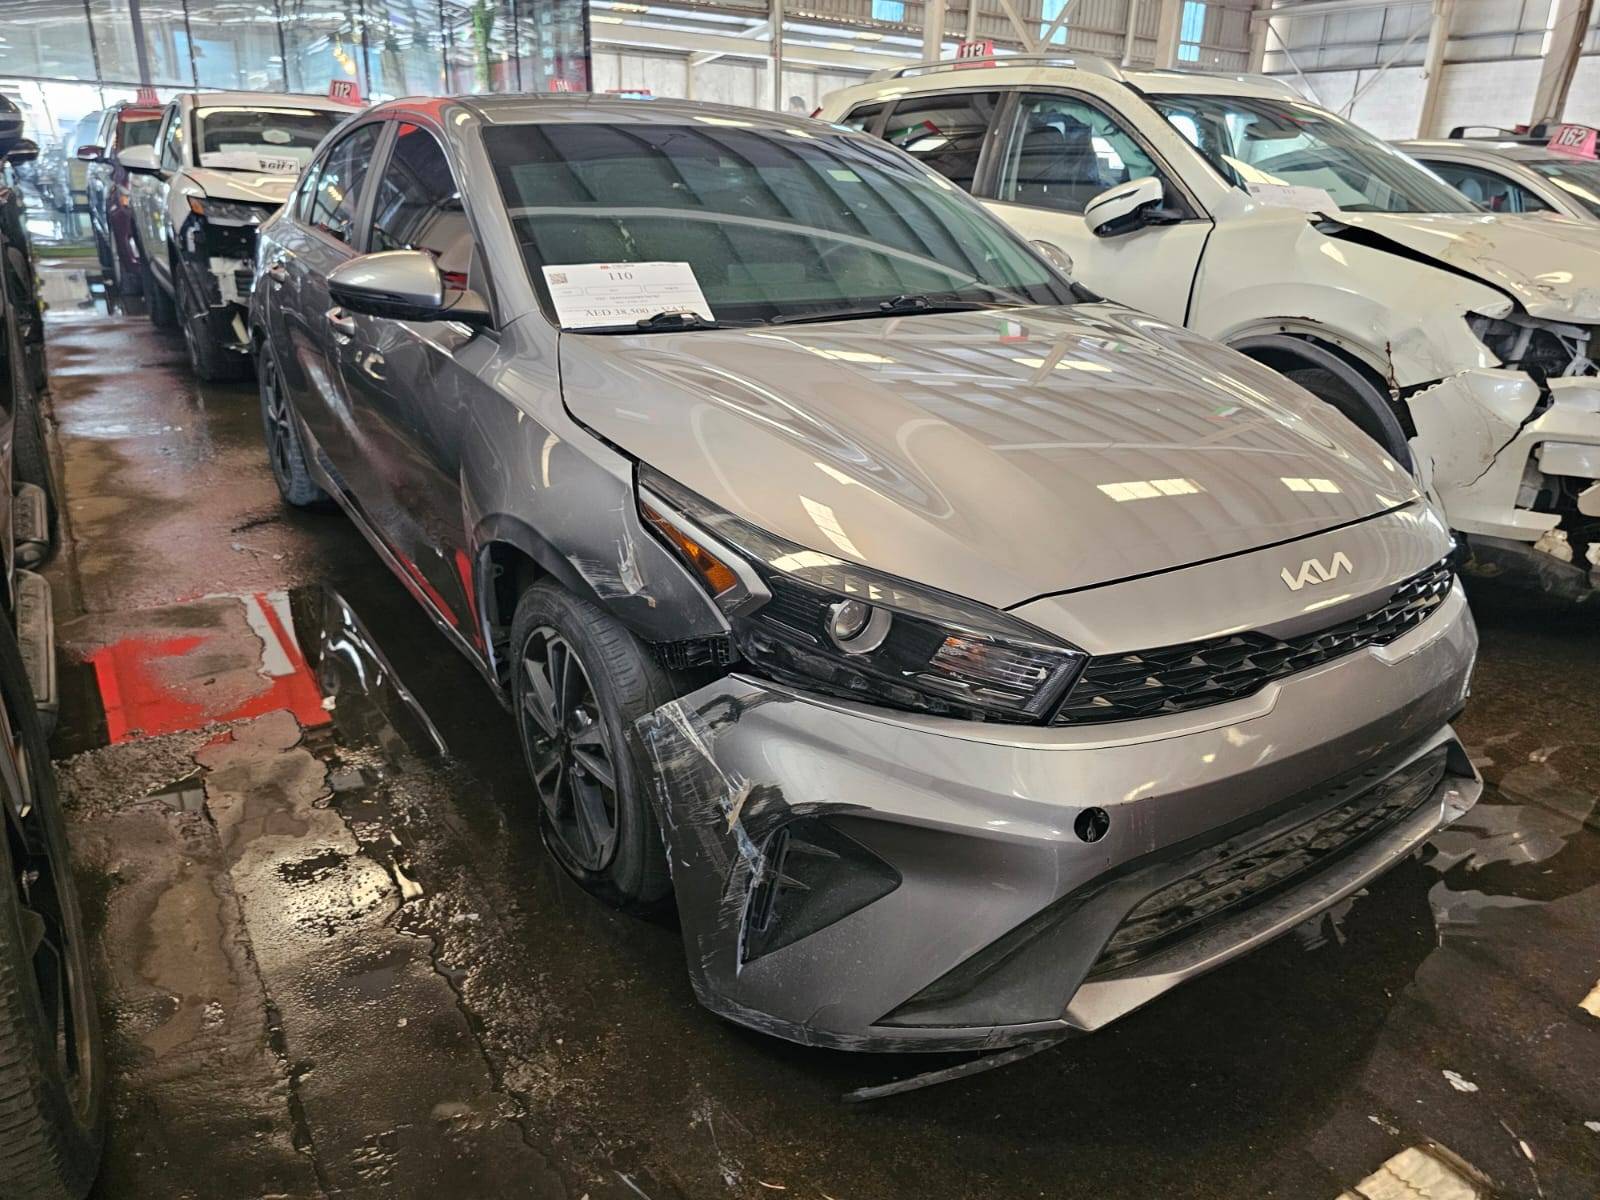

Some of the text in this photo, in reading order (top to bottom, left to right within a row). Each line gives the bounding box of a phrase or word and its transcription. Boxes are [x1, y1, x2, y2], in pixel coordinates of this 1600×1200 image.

[333, 82, 352, 98] 112
[1558, 127, 1587, 147] 162
[608, 271, 634, 282] 110
[585, 309, 612, 317] AED
[1281, 552, 1353, 591] KIA
